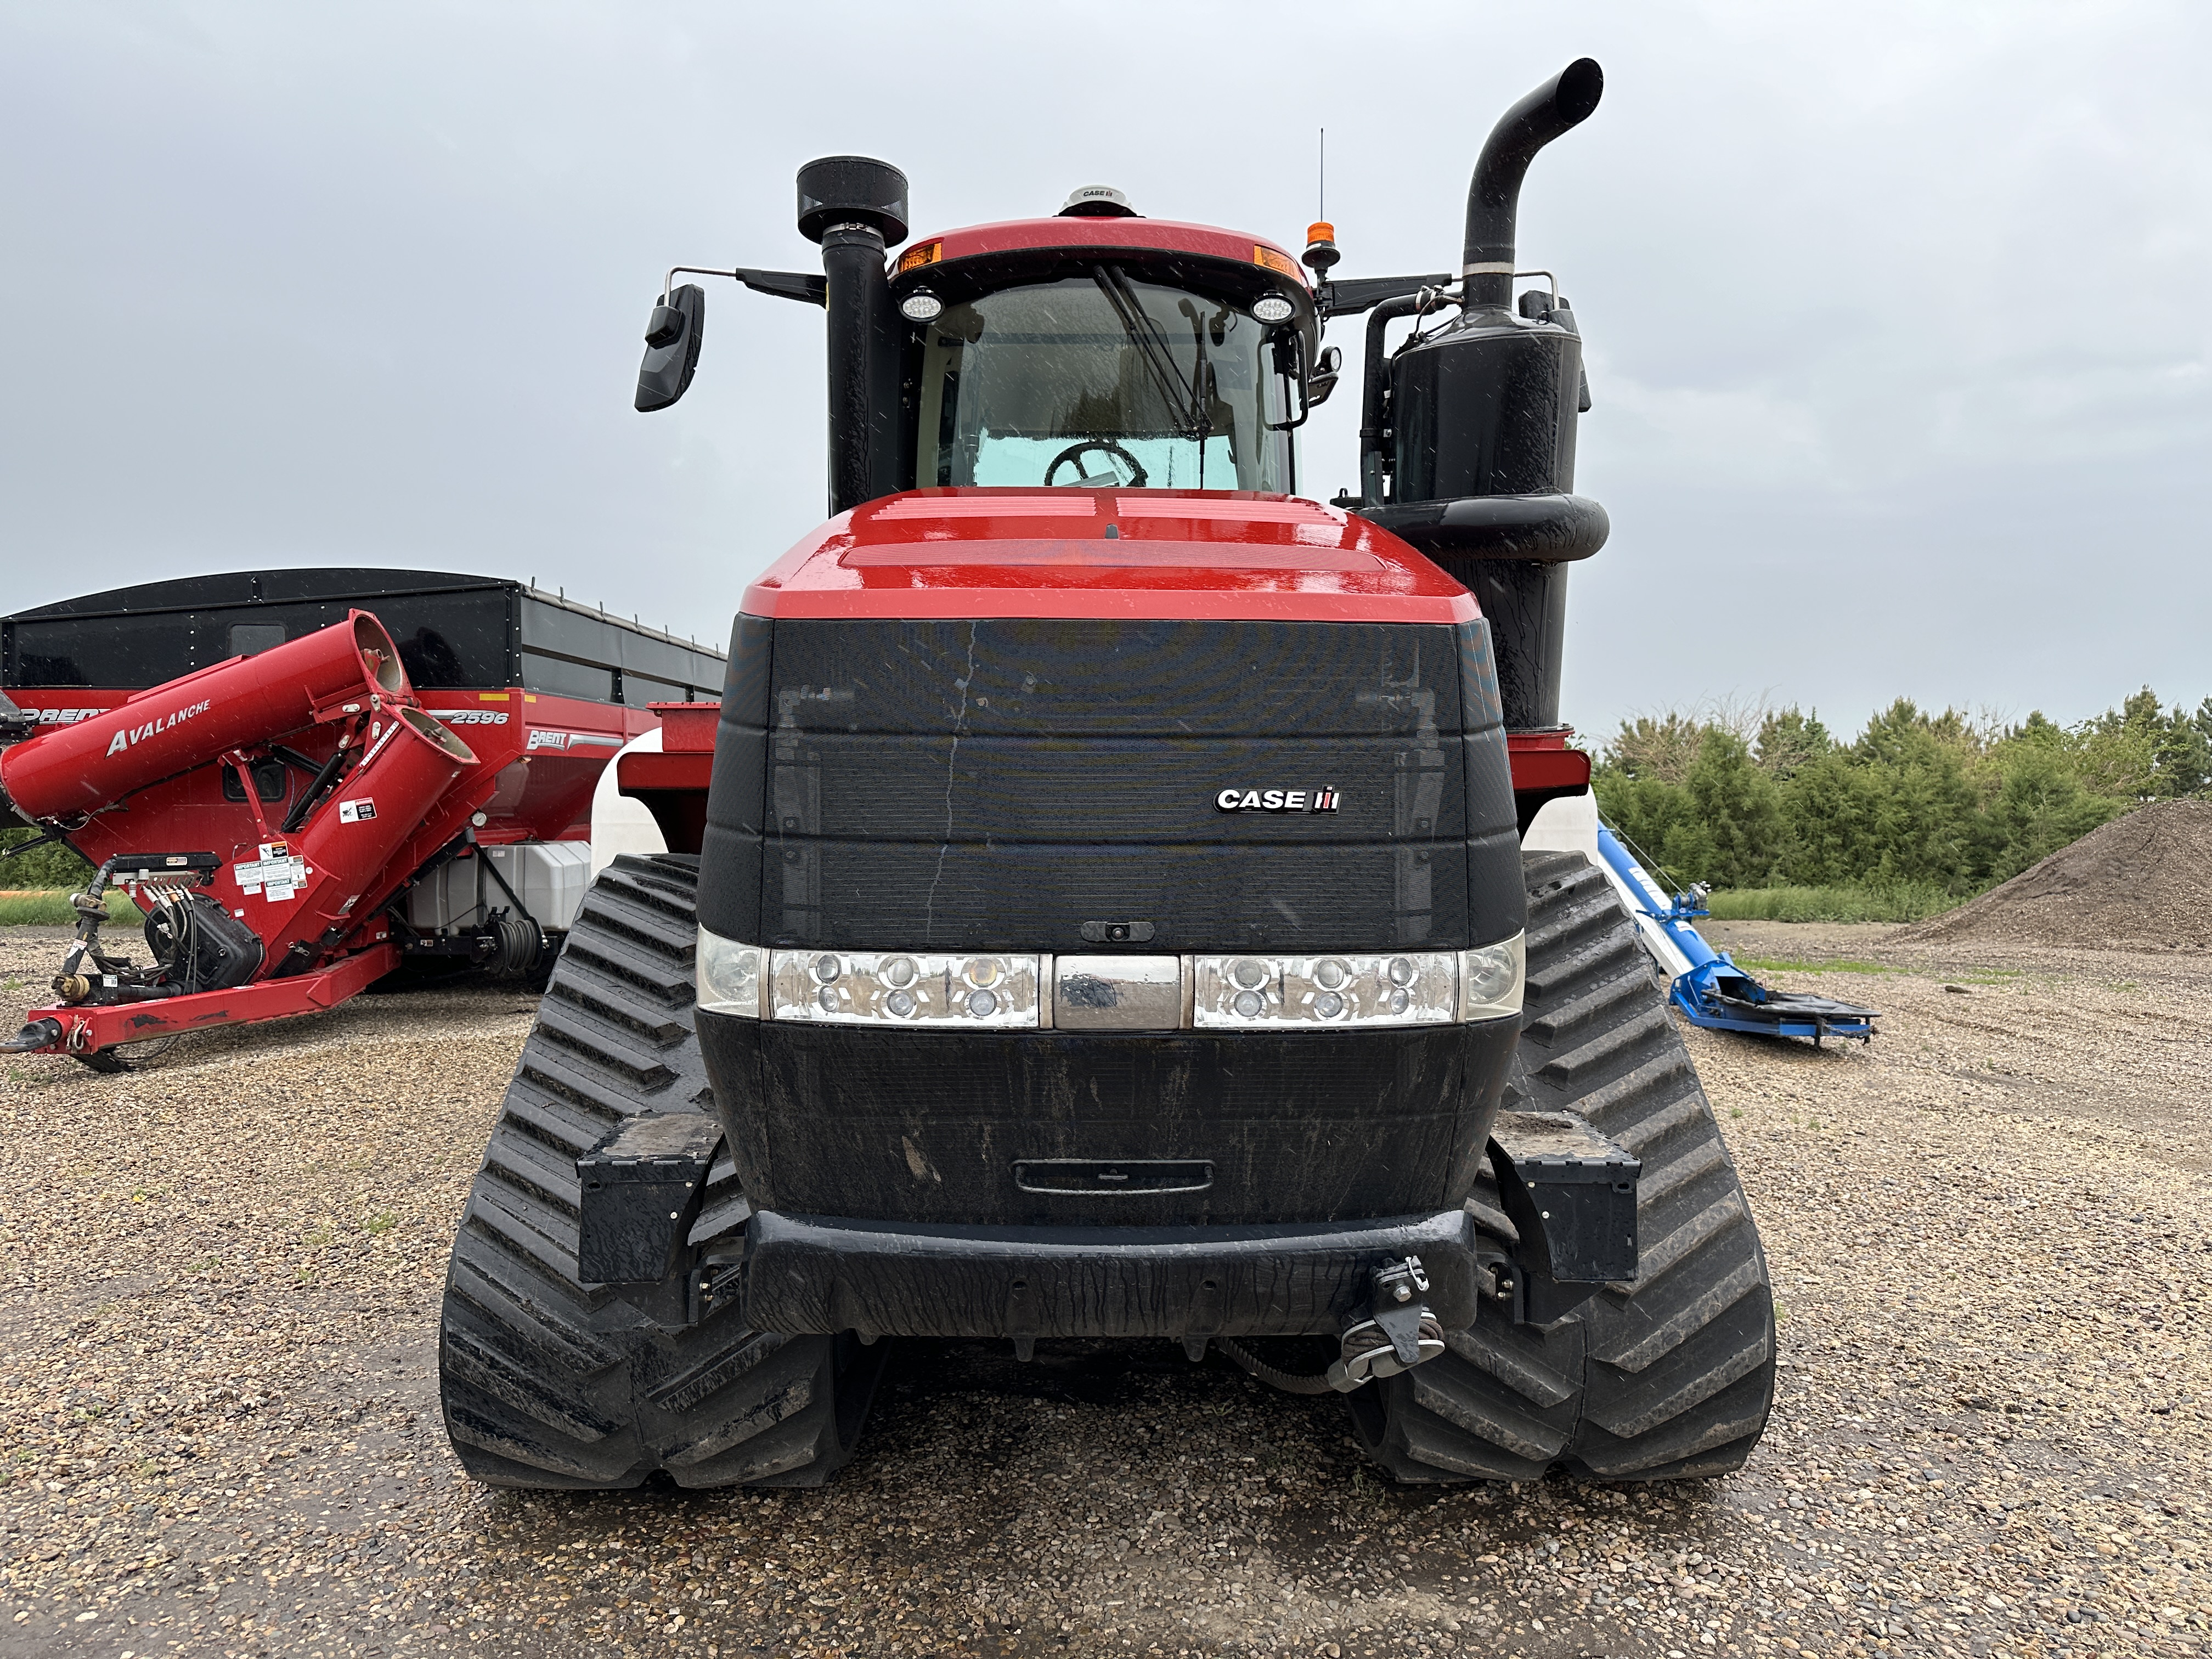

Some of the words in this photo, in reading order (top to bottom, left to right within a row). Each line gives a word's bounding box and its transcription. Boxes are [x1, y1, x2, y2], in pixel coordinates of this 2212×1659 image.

[450, 712, 509, 725] 2596
[104, 699, 211, 759] AVALANCHE
[527, 730, 567, 750] BRENT
[1217, 789, 1307, 809] CASE
[235, 862, 260, 870] IMPORTANT
